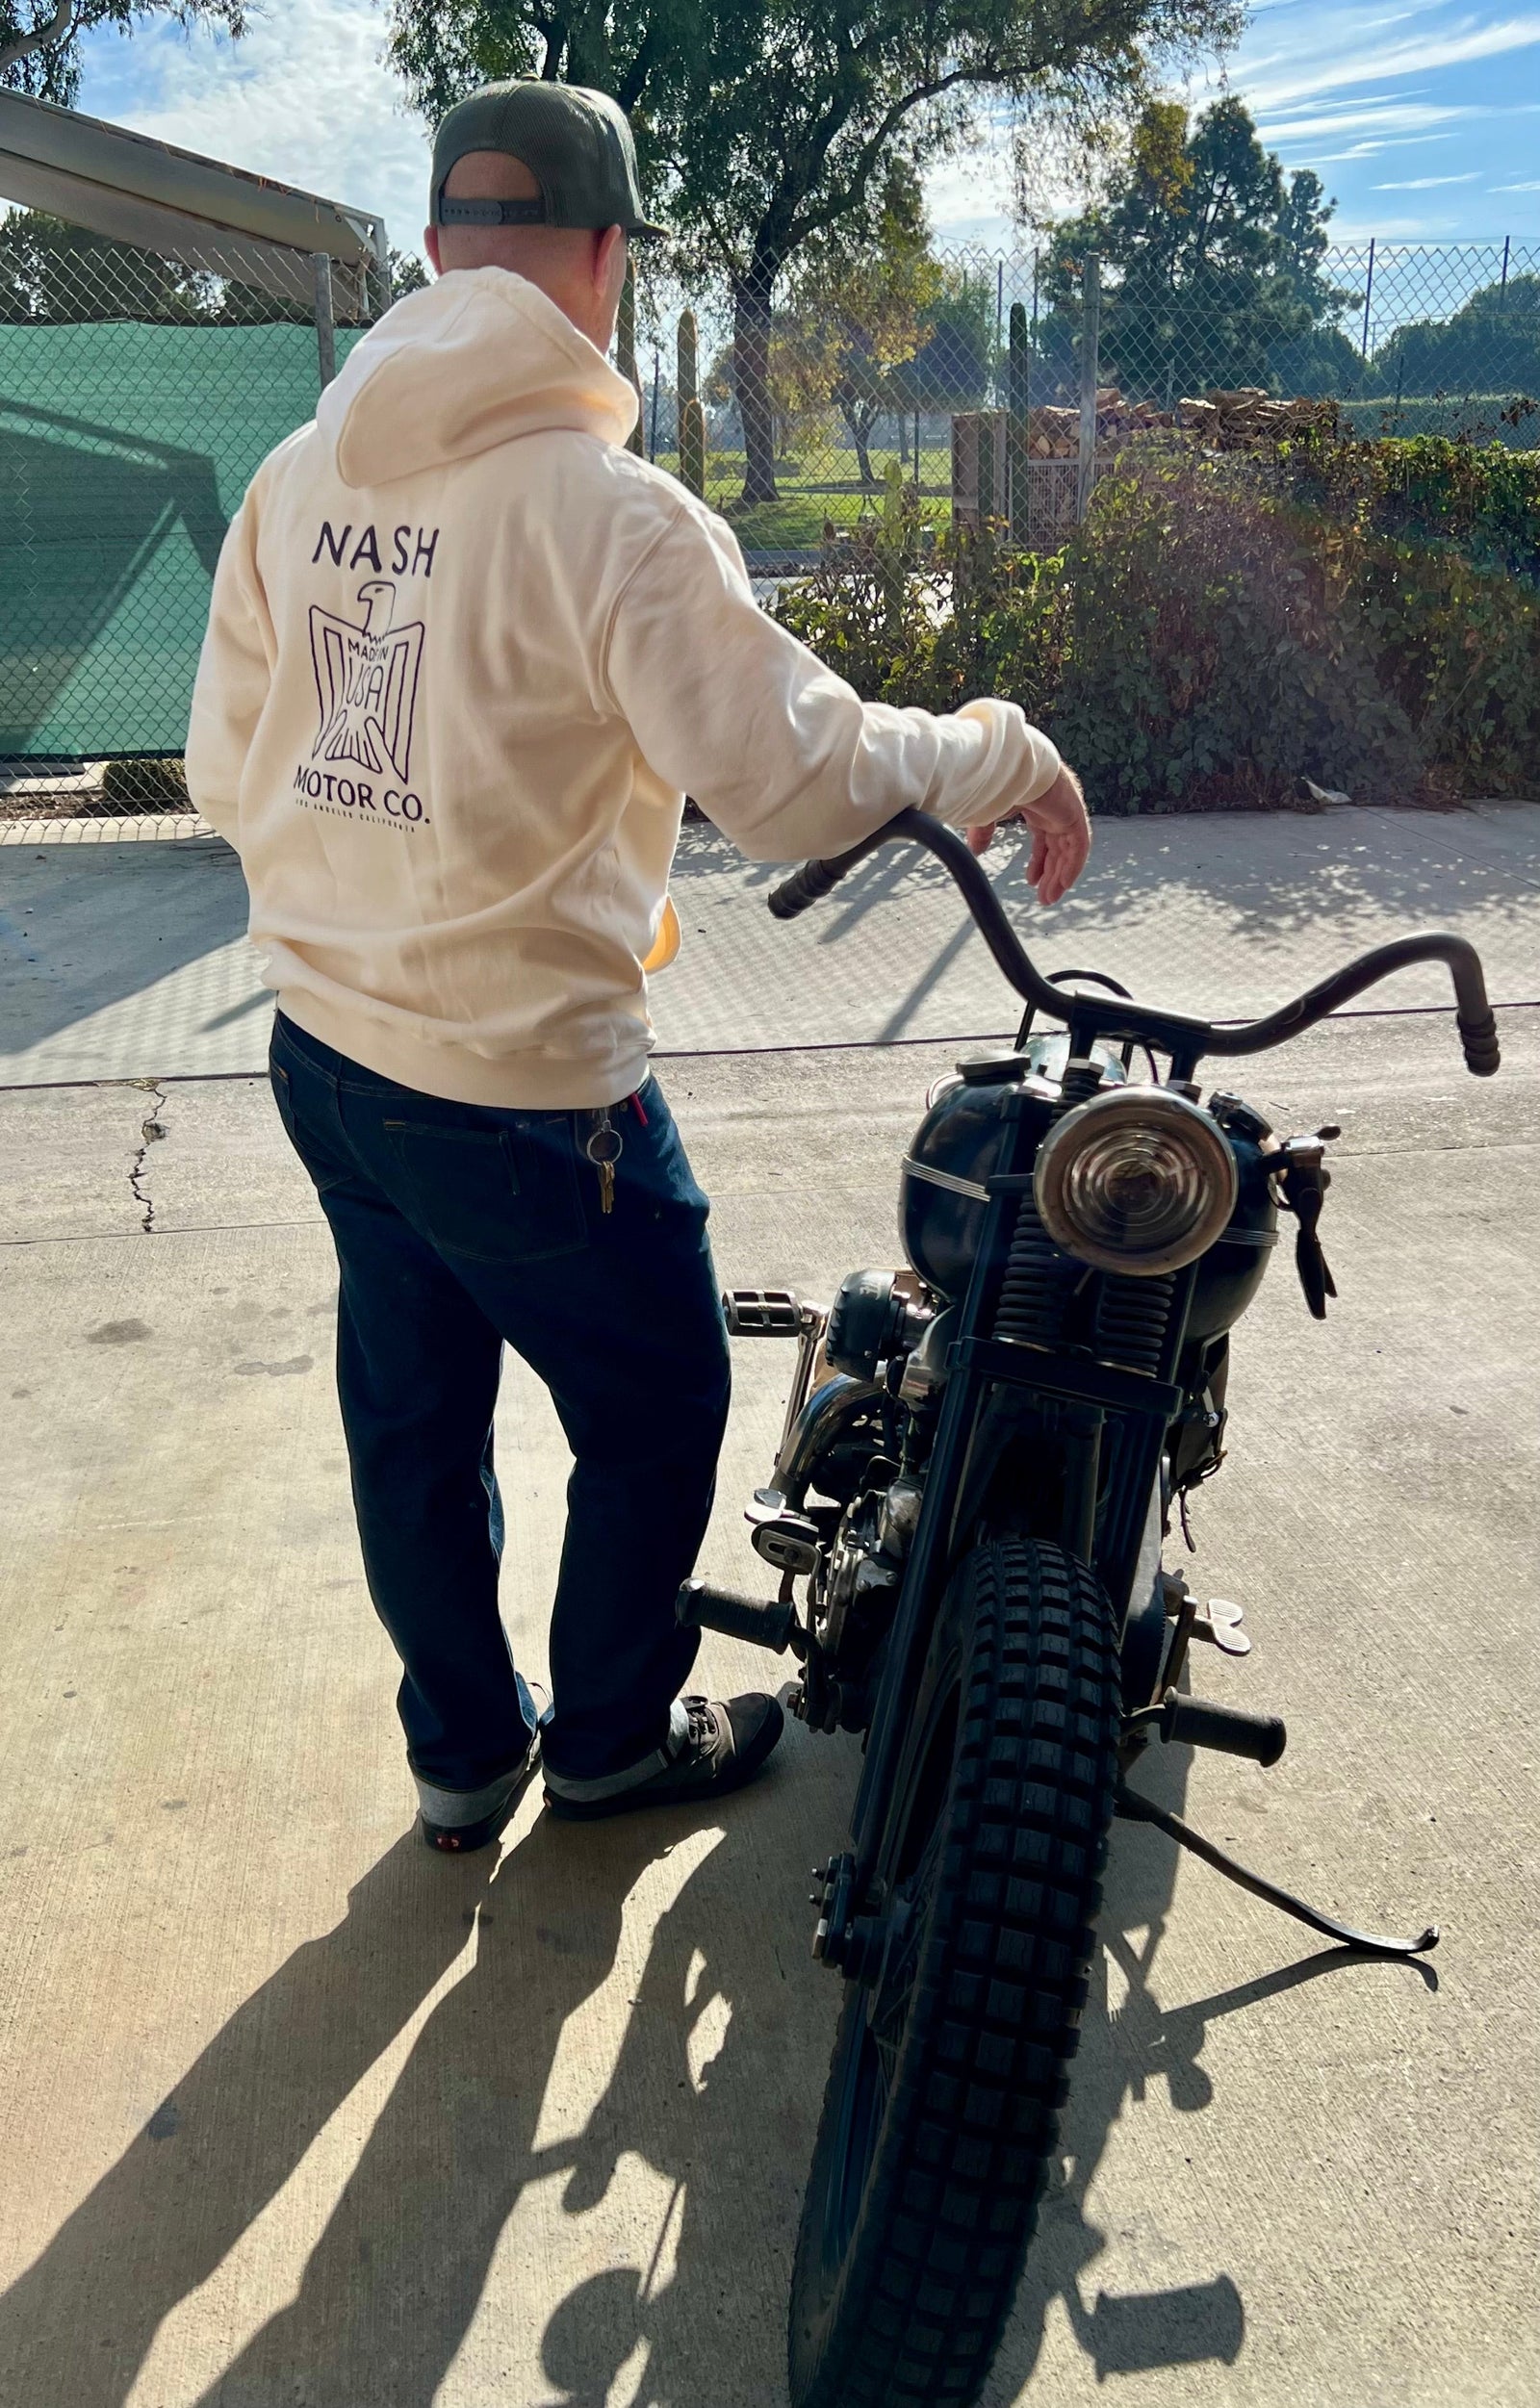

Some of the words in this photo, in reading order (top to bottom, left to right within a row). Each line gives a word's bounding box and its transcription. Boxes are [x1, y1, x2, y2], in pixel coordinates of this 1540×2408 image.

[312, 521, 440, 577] NASH
[346, 656, 384, 712] USA
[294, 765, 377, 810] MOTOR
[384, 789, 430, 824] CO.
[359, 814, 415, 833] CALIFORNIA
